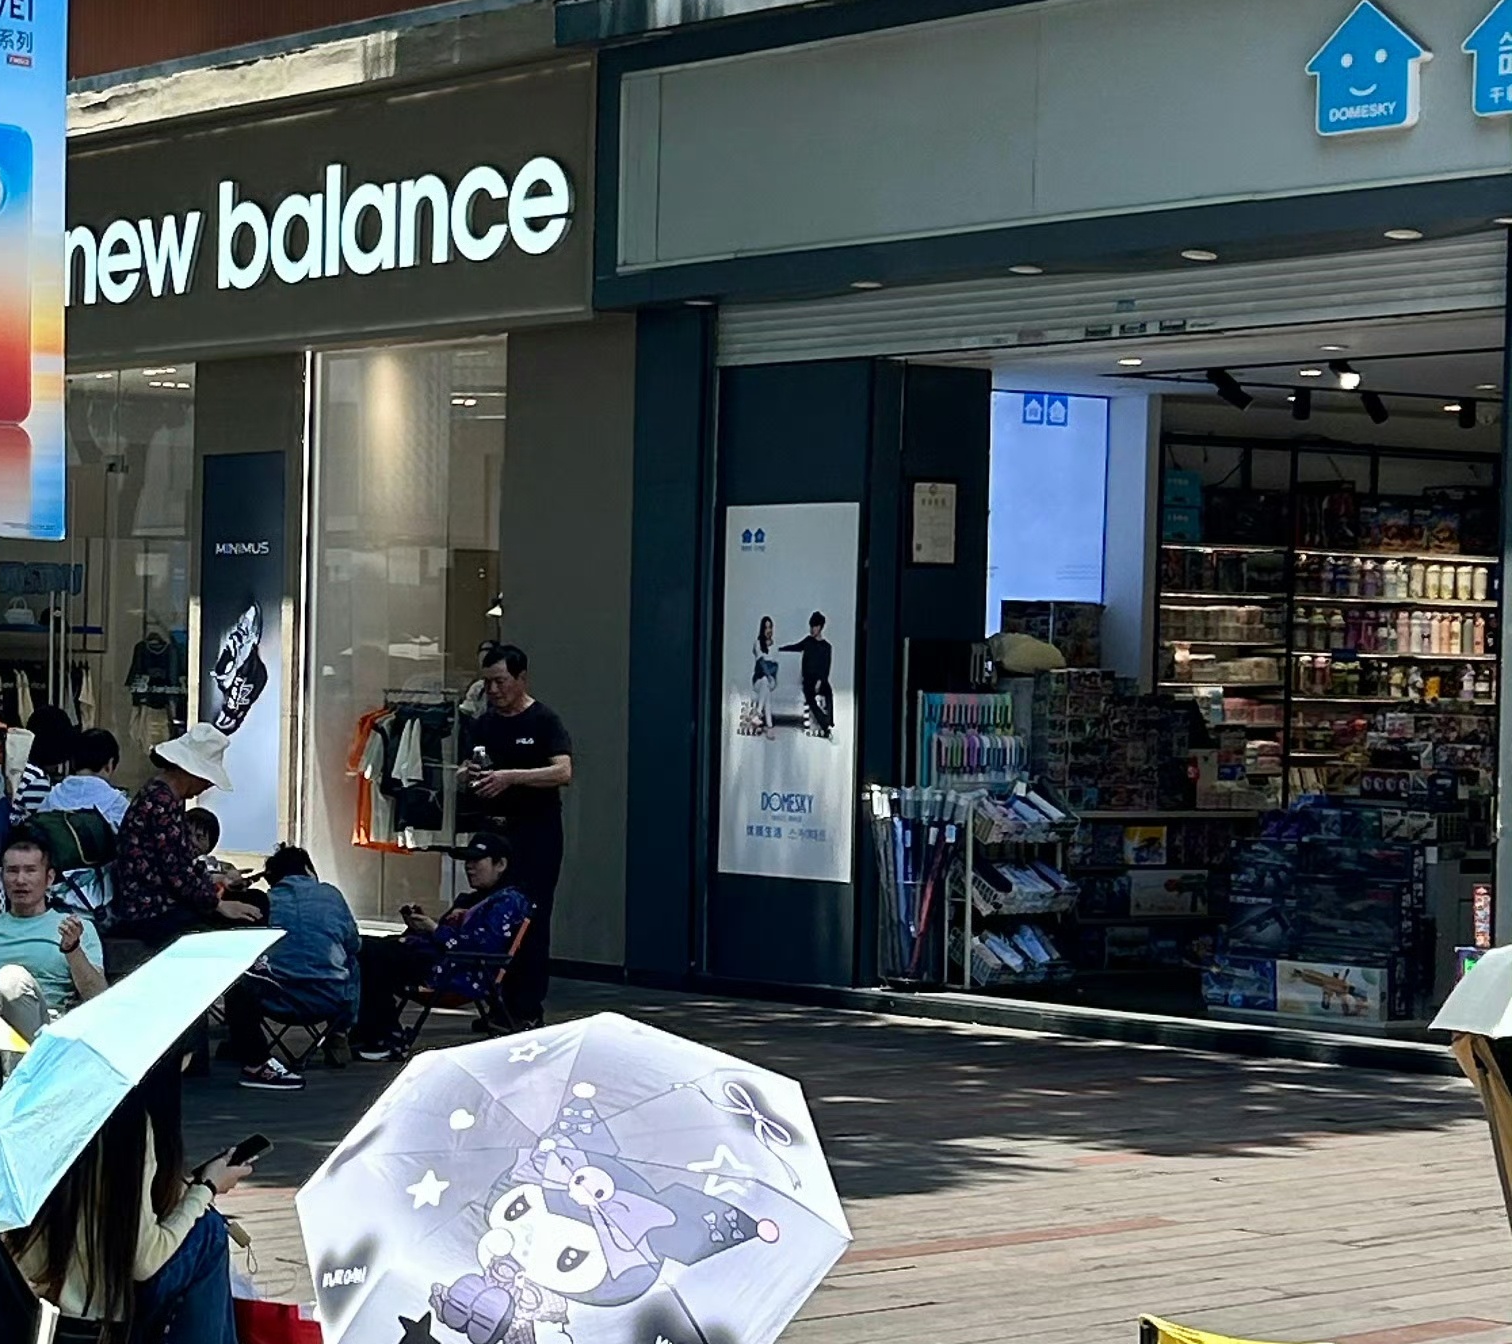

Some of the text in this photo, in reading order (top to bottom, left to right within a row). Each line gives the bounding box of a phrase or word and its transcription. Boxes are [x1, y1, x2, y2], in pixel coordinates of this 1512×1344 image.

[1328, 102, 1397, 123] DOMESKY
[65, 156, 573, 307] new balance
[215, 542, 269, 555] MINIMUS
